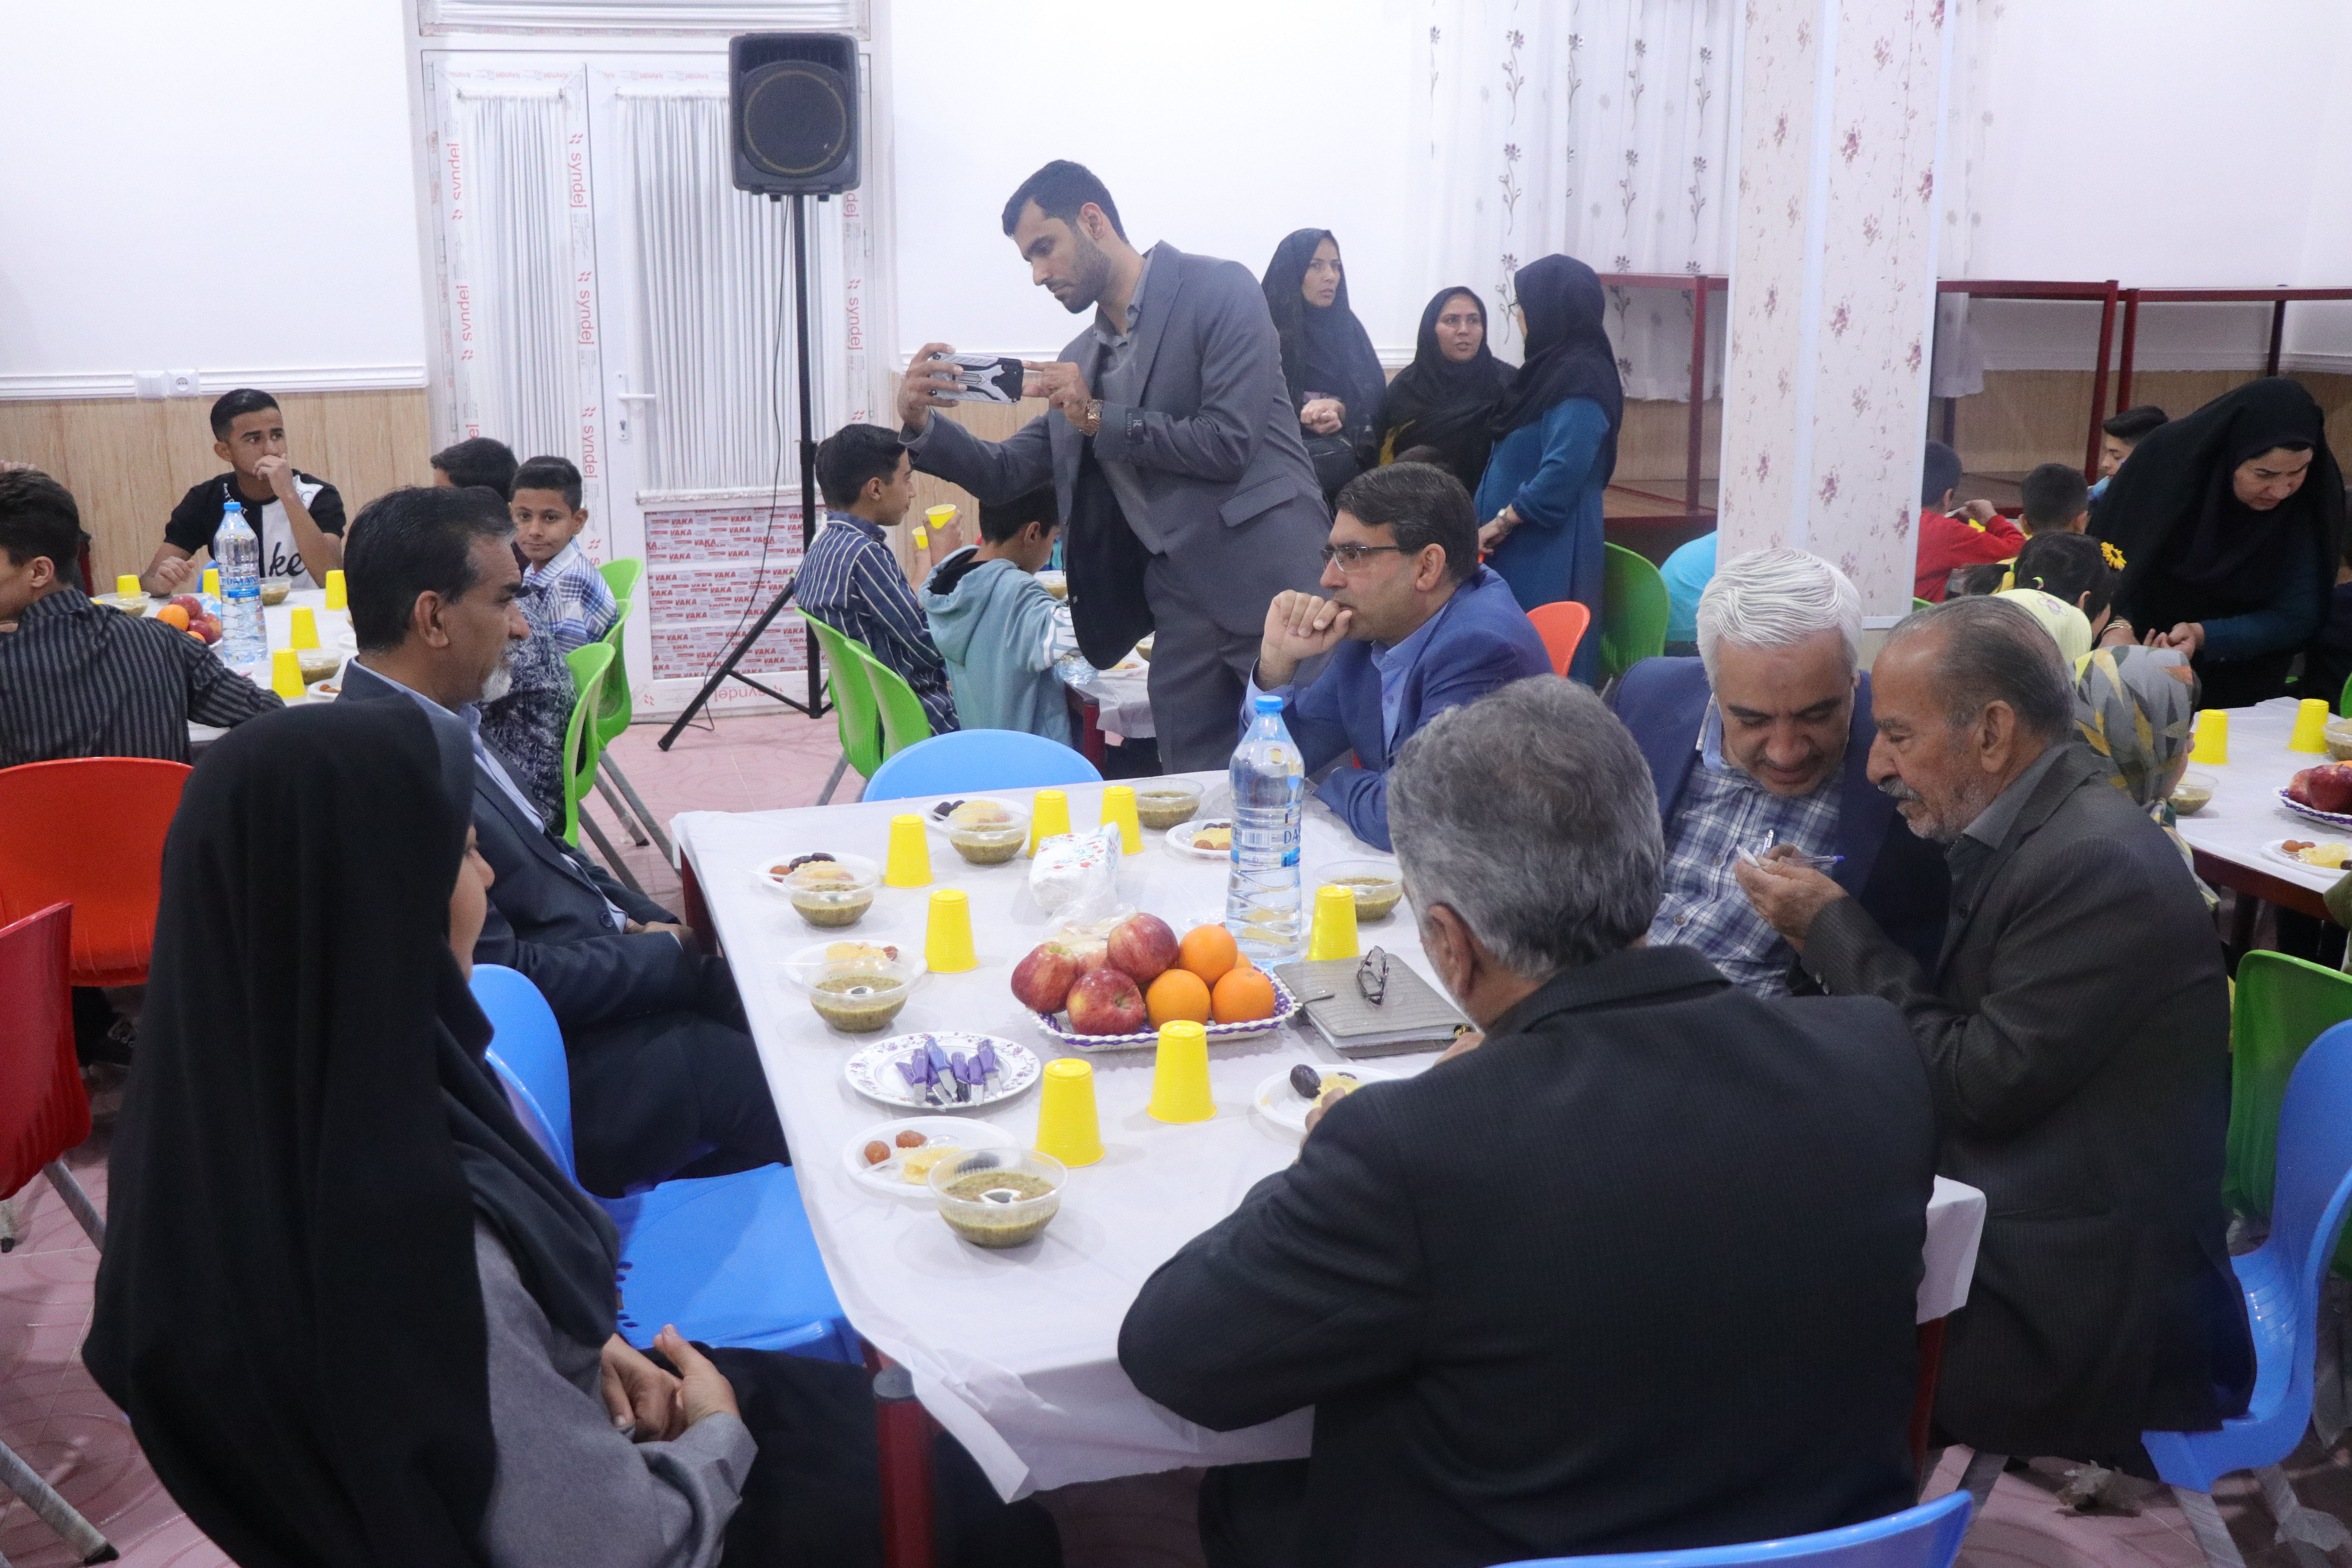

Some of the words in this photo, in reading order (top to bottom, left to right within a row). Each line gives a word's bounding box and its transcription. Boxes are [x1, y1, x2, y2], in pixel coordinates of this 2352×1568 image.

[568, 152, 587, 208] syndej
[844, 192, 859, 217] dej
[577, 290, 595, 345] syndej
[846, 297, 863, 350] syndej
[695, 539, 716, 547] VAKA
[1284, 829, 1300, 844] DA
